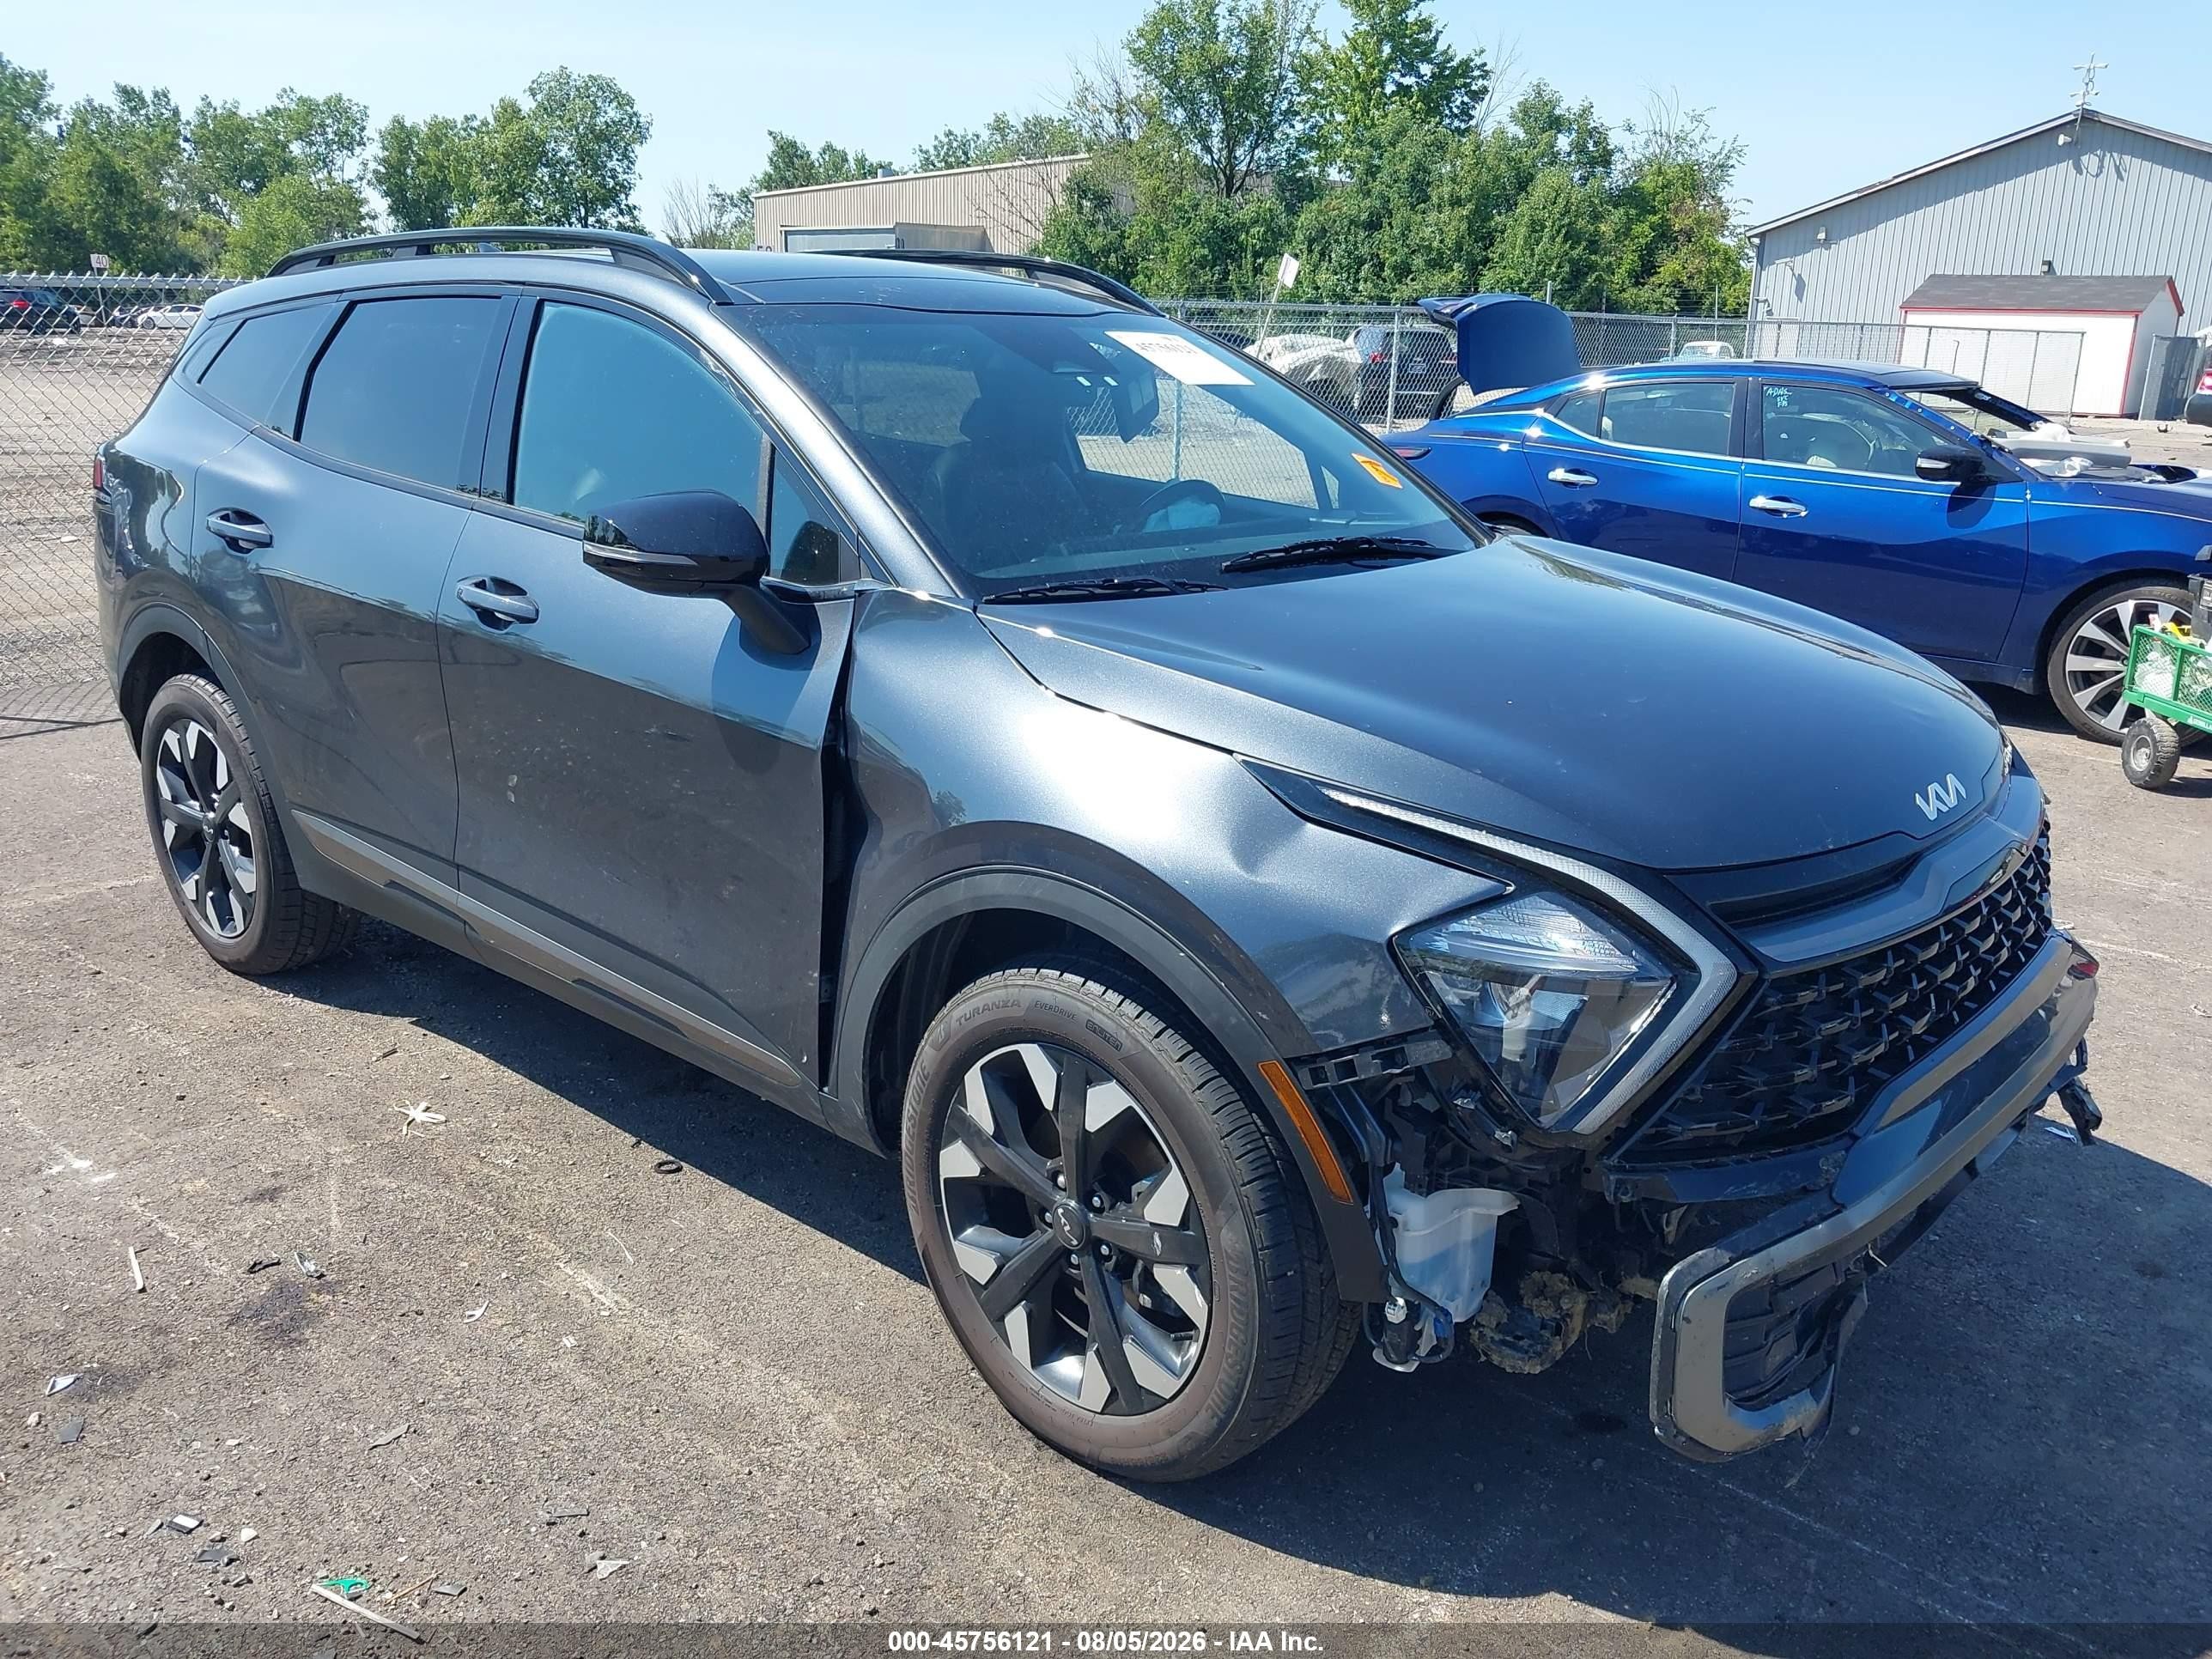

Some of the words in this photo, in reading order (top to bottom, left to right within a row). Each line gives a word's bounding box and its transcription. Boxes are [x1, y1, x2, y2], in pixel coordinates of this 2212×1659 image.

[95, 255, 107, 267] 40
[955, 999, 1022, 1026] TURANZA
[1034, 1000, 1078, 1020] EVERDRIVE
